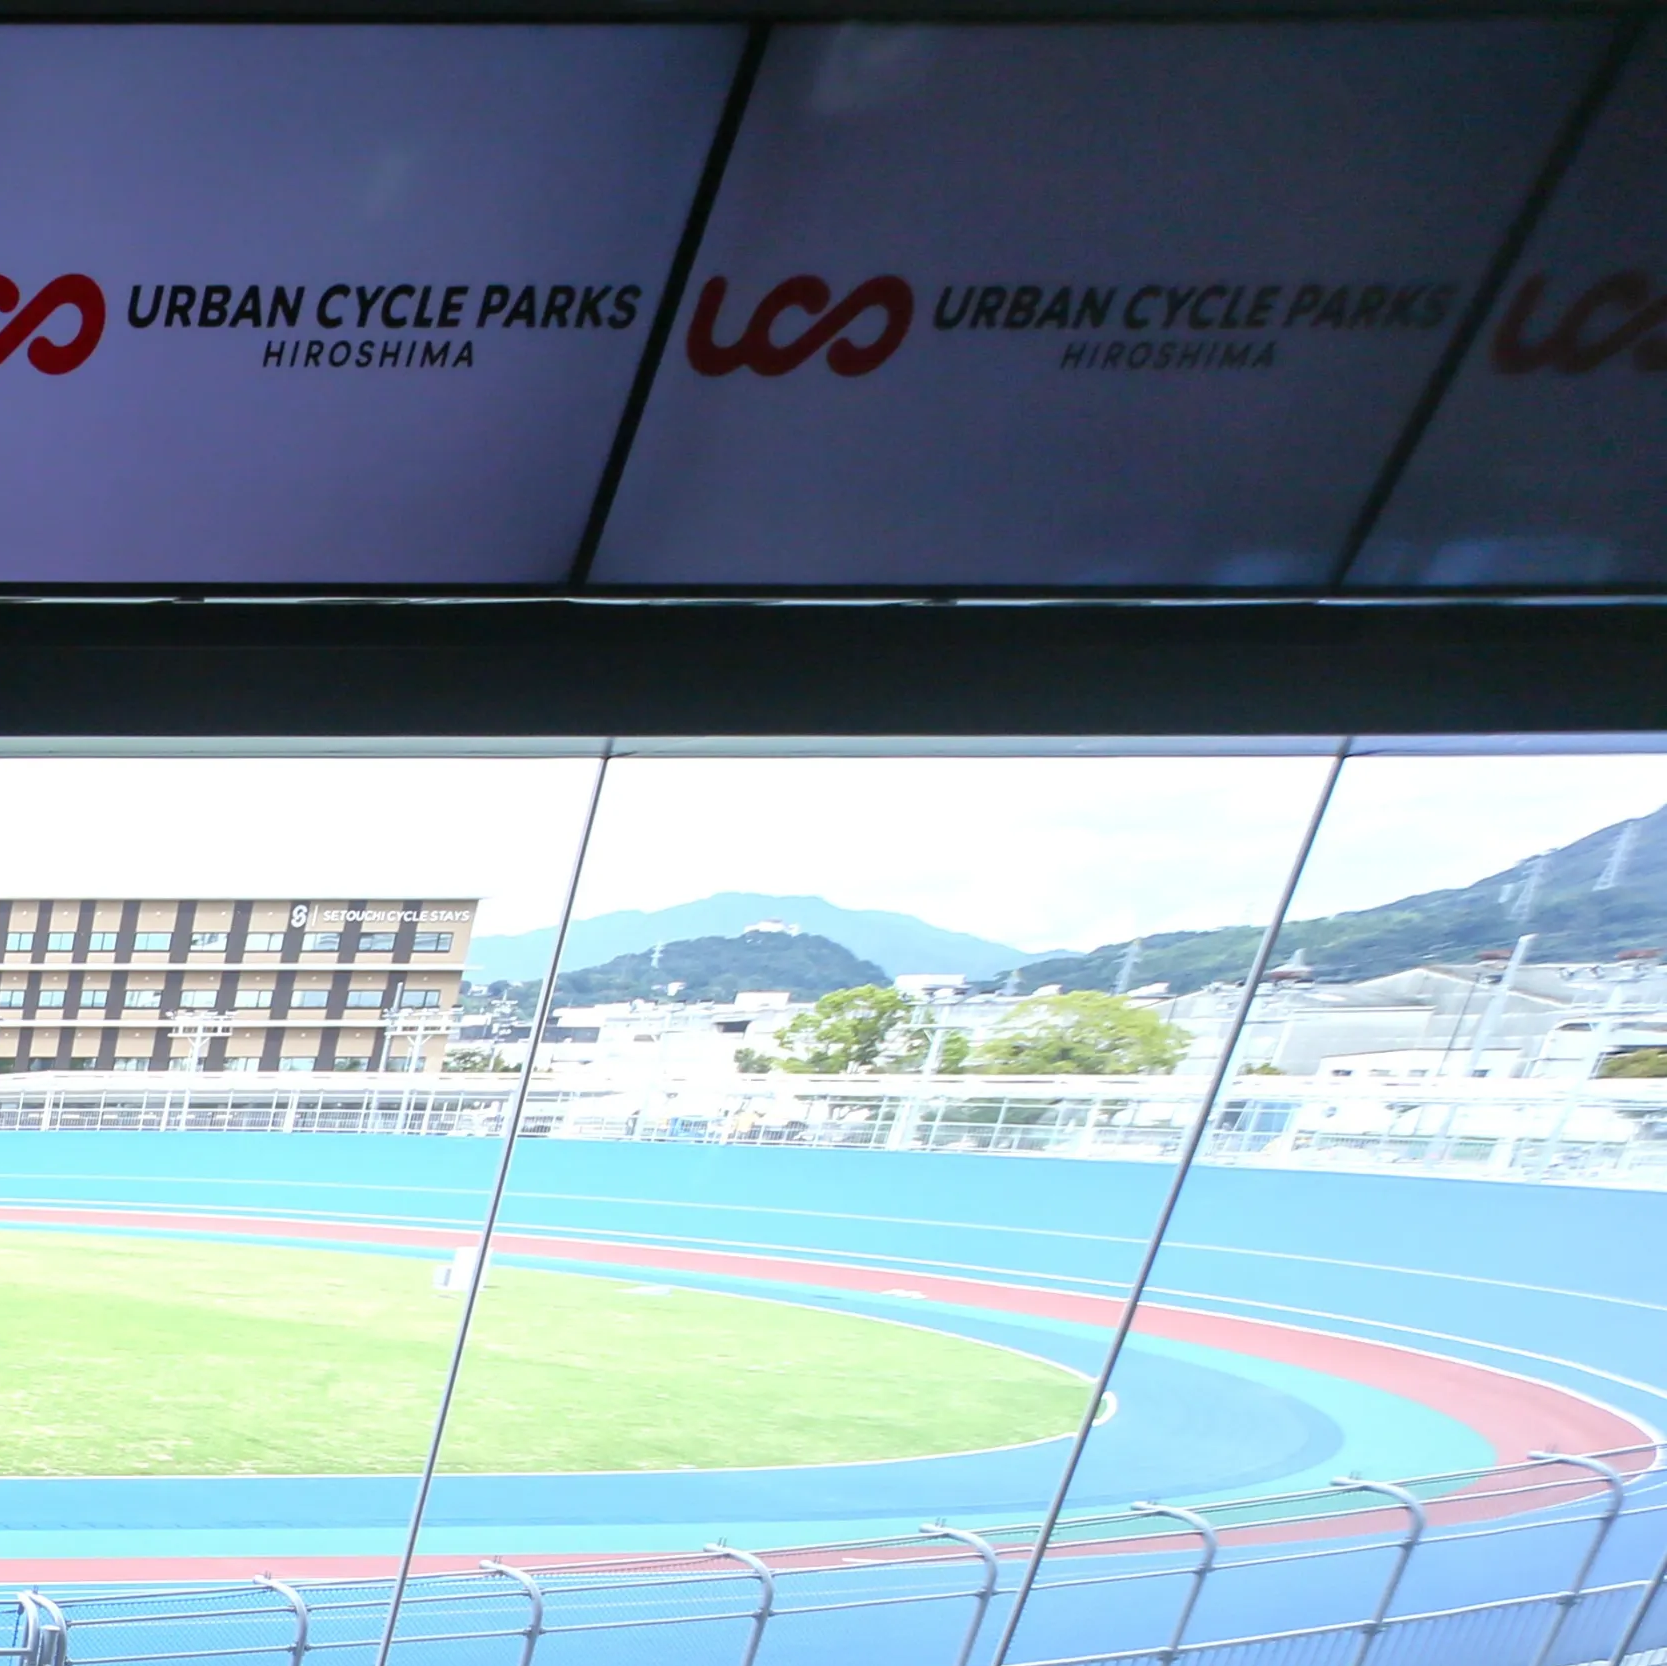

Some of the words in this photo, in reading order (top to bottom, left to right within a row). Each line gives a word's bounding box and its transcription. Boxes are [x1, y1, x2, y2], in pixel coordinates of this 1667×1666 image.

[127, 284, 306, 331] URBAN
[316, 284, 468, 330] CYCLE
[475, 284, 642, 330] PARKS
[932, 284, 1110, 331] URBAN
[1123, 284, 1281, 330] CYCLE
[1284, 284, 1454, 332] PARKS
[262, 339, 474, 368] HIROSHIMA
[1060, 340, 1277, 370] HIROSHIMA
[323, 909, 386, 922] SETOUCHI
[387, 909, 428, 923] CYCLE
[428, 910, 471, 923] STAYS
